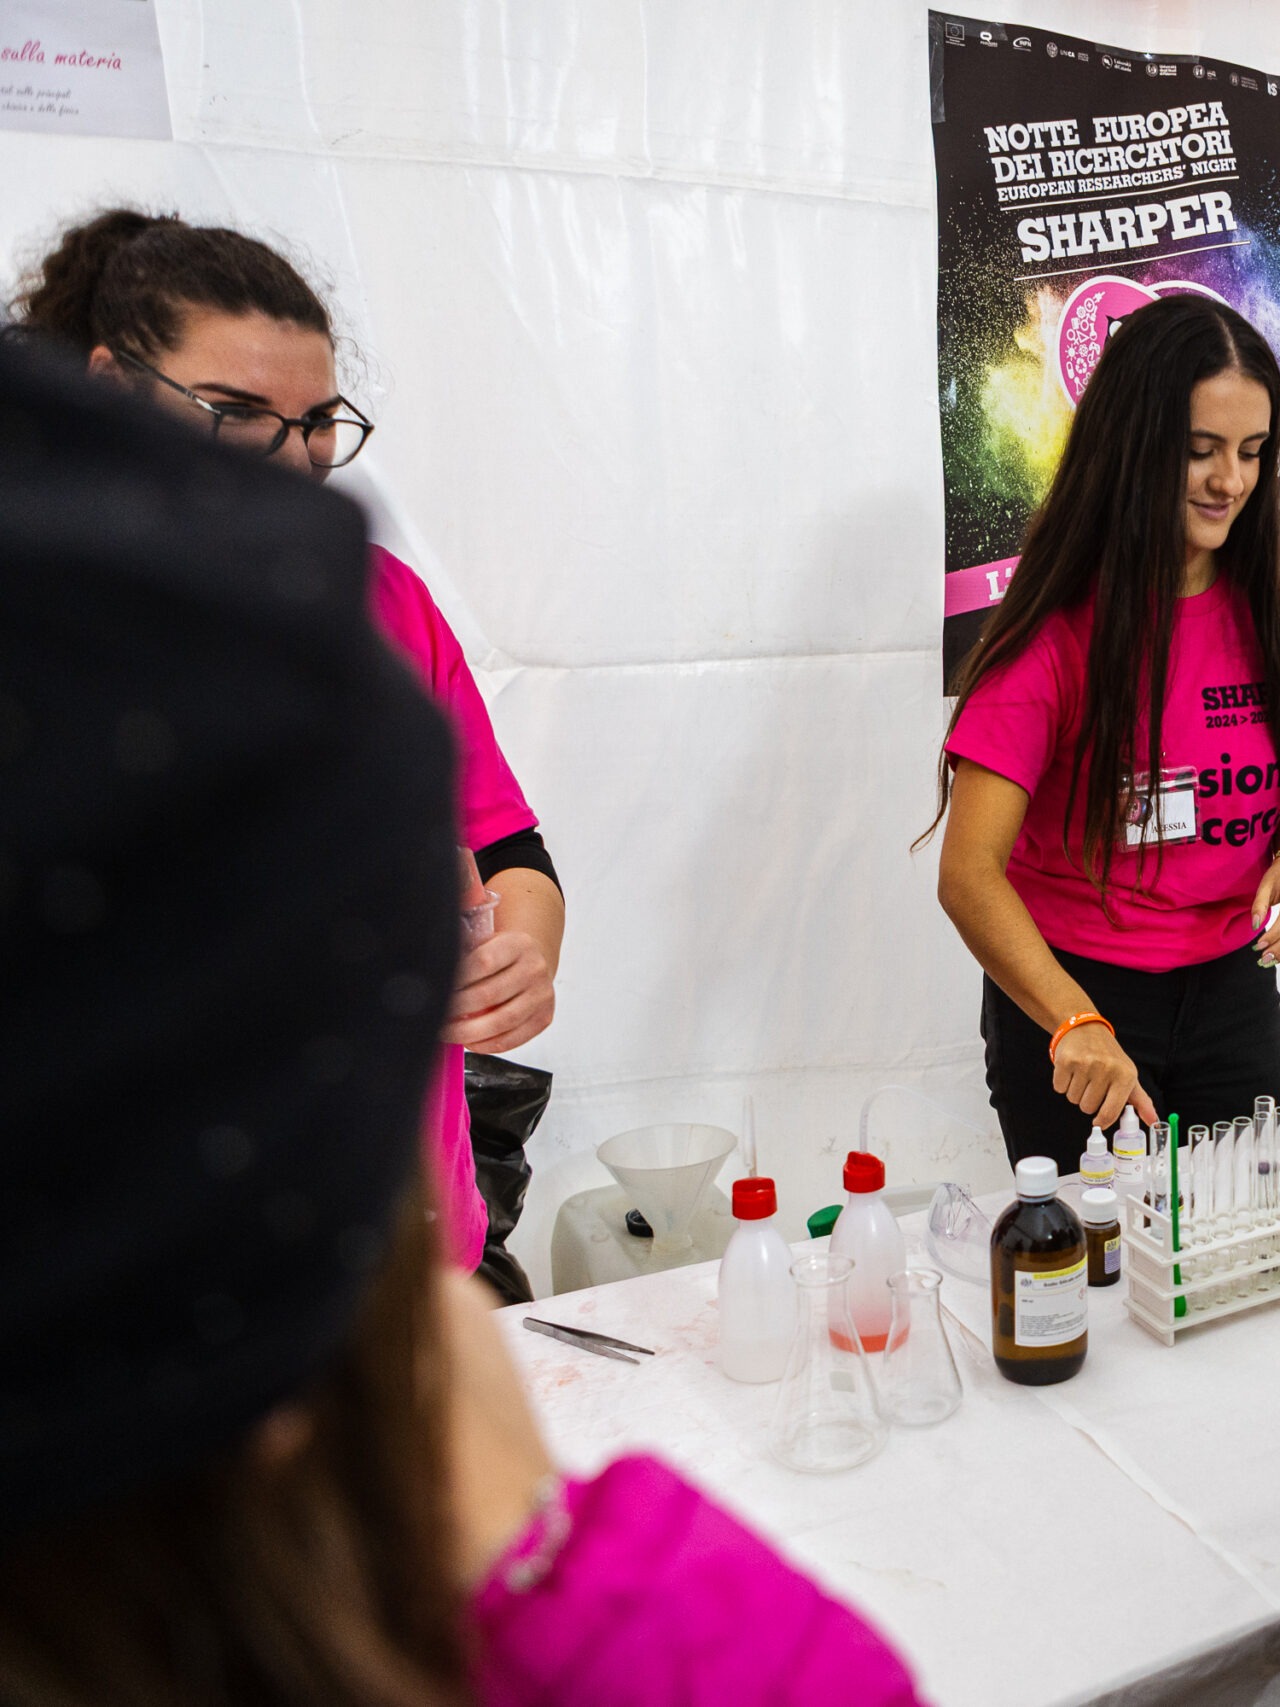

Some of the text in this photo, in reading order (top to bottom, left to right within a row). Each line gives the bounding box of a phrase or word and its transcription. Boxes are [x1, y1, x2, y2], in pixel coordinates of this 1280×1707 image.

[1, 40, 122, 70] sulla materia
[983, 101, 1229, 153] NOTTE EUROPEA
[991, 129, 1235, 184] DEI RICERCATORI
[997, 157, 1238, 202] EUROPEAN RESEARCHERS' NIGHT
[1016, 190, 1238, 263] SHARPER
[1205, 713, 1239, 728] 2024
